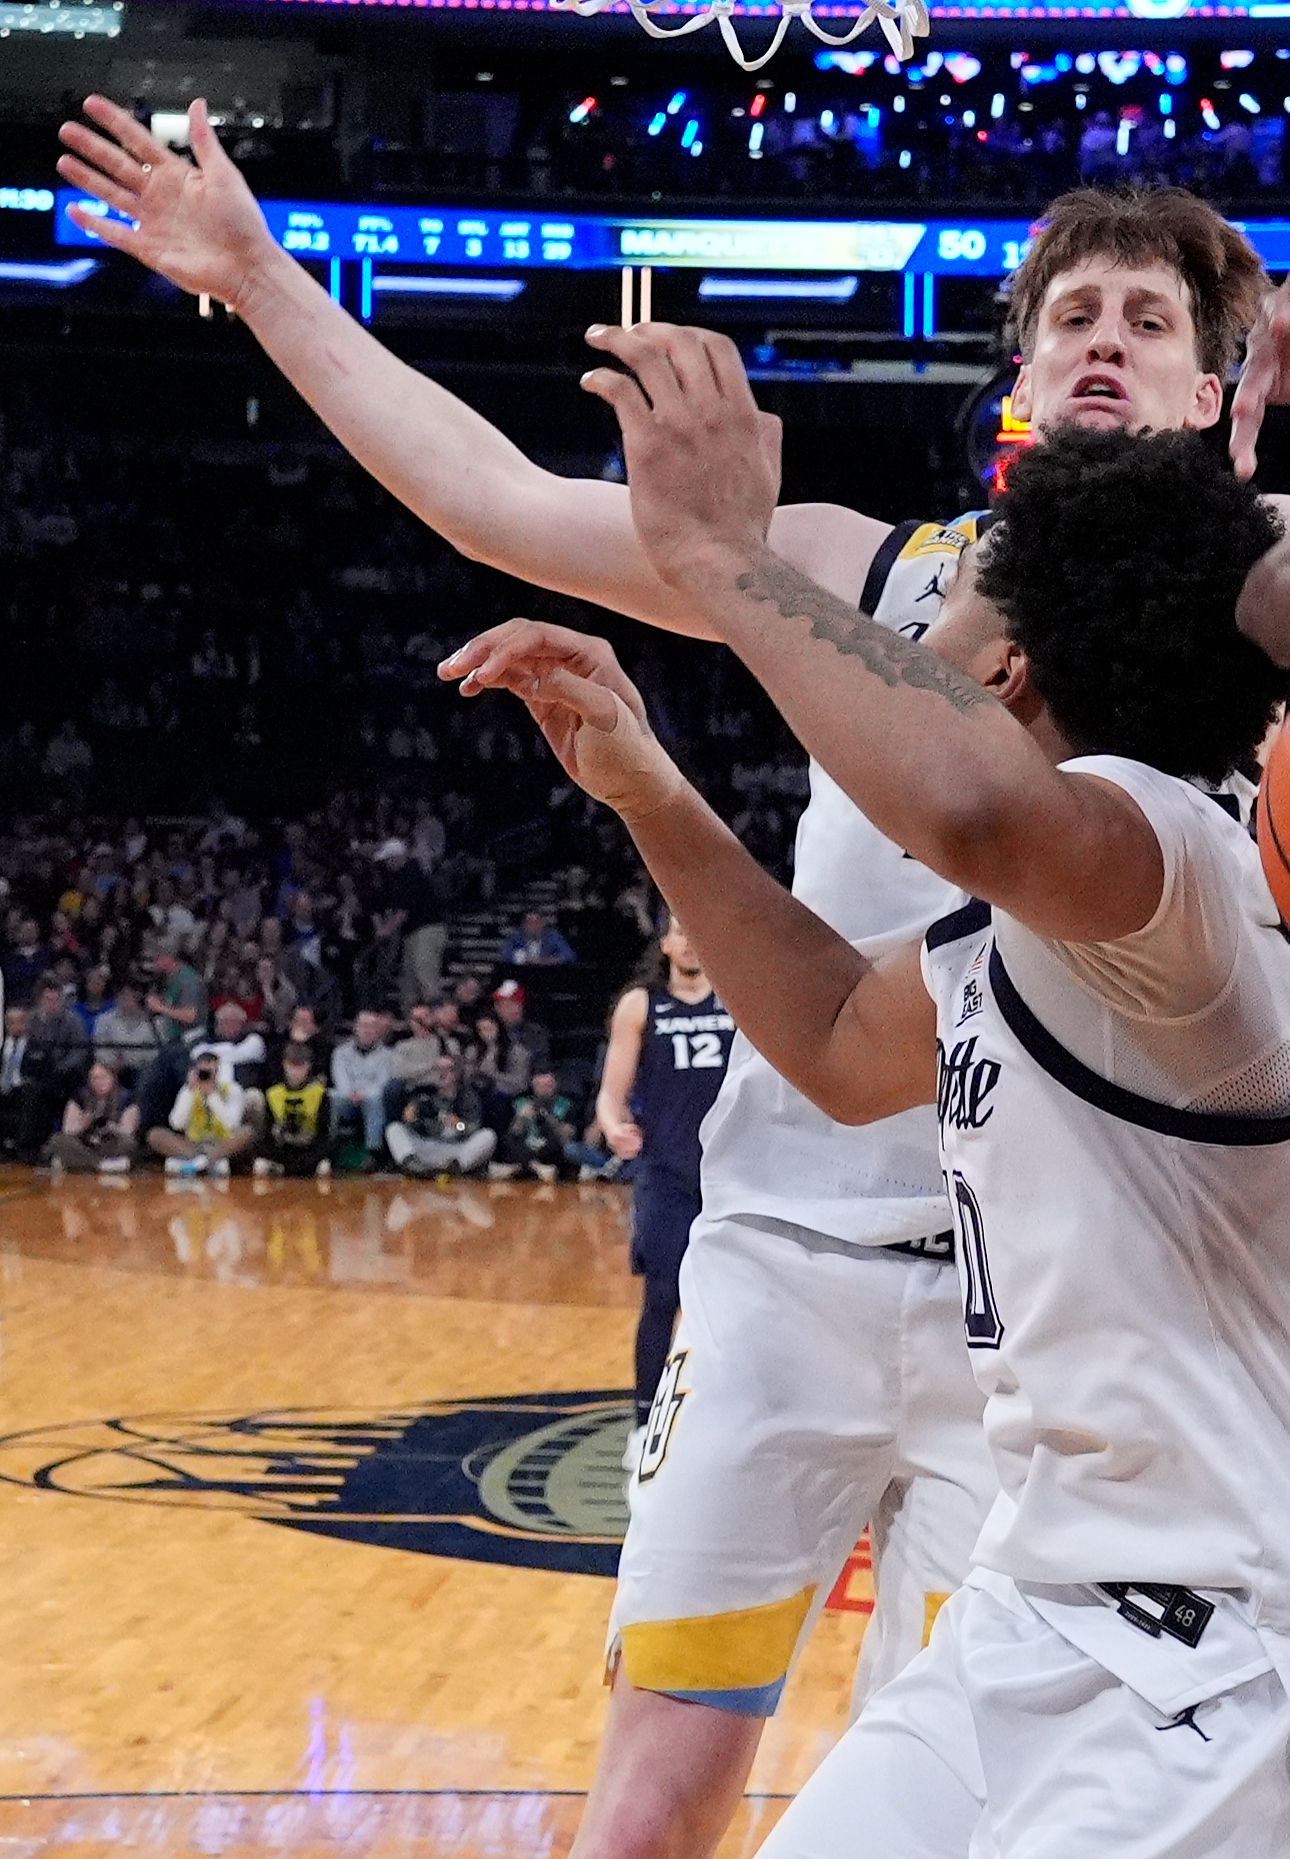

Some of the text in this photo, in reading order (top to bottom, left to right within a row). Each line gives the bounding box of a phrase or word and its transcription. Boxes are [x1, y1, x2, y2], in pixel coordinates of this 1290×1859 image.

[937, 229, 987, 260] 50
[672, 1032, 724, 1070] 12
[1174, 1604, 1197, 1628] 48
